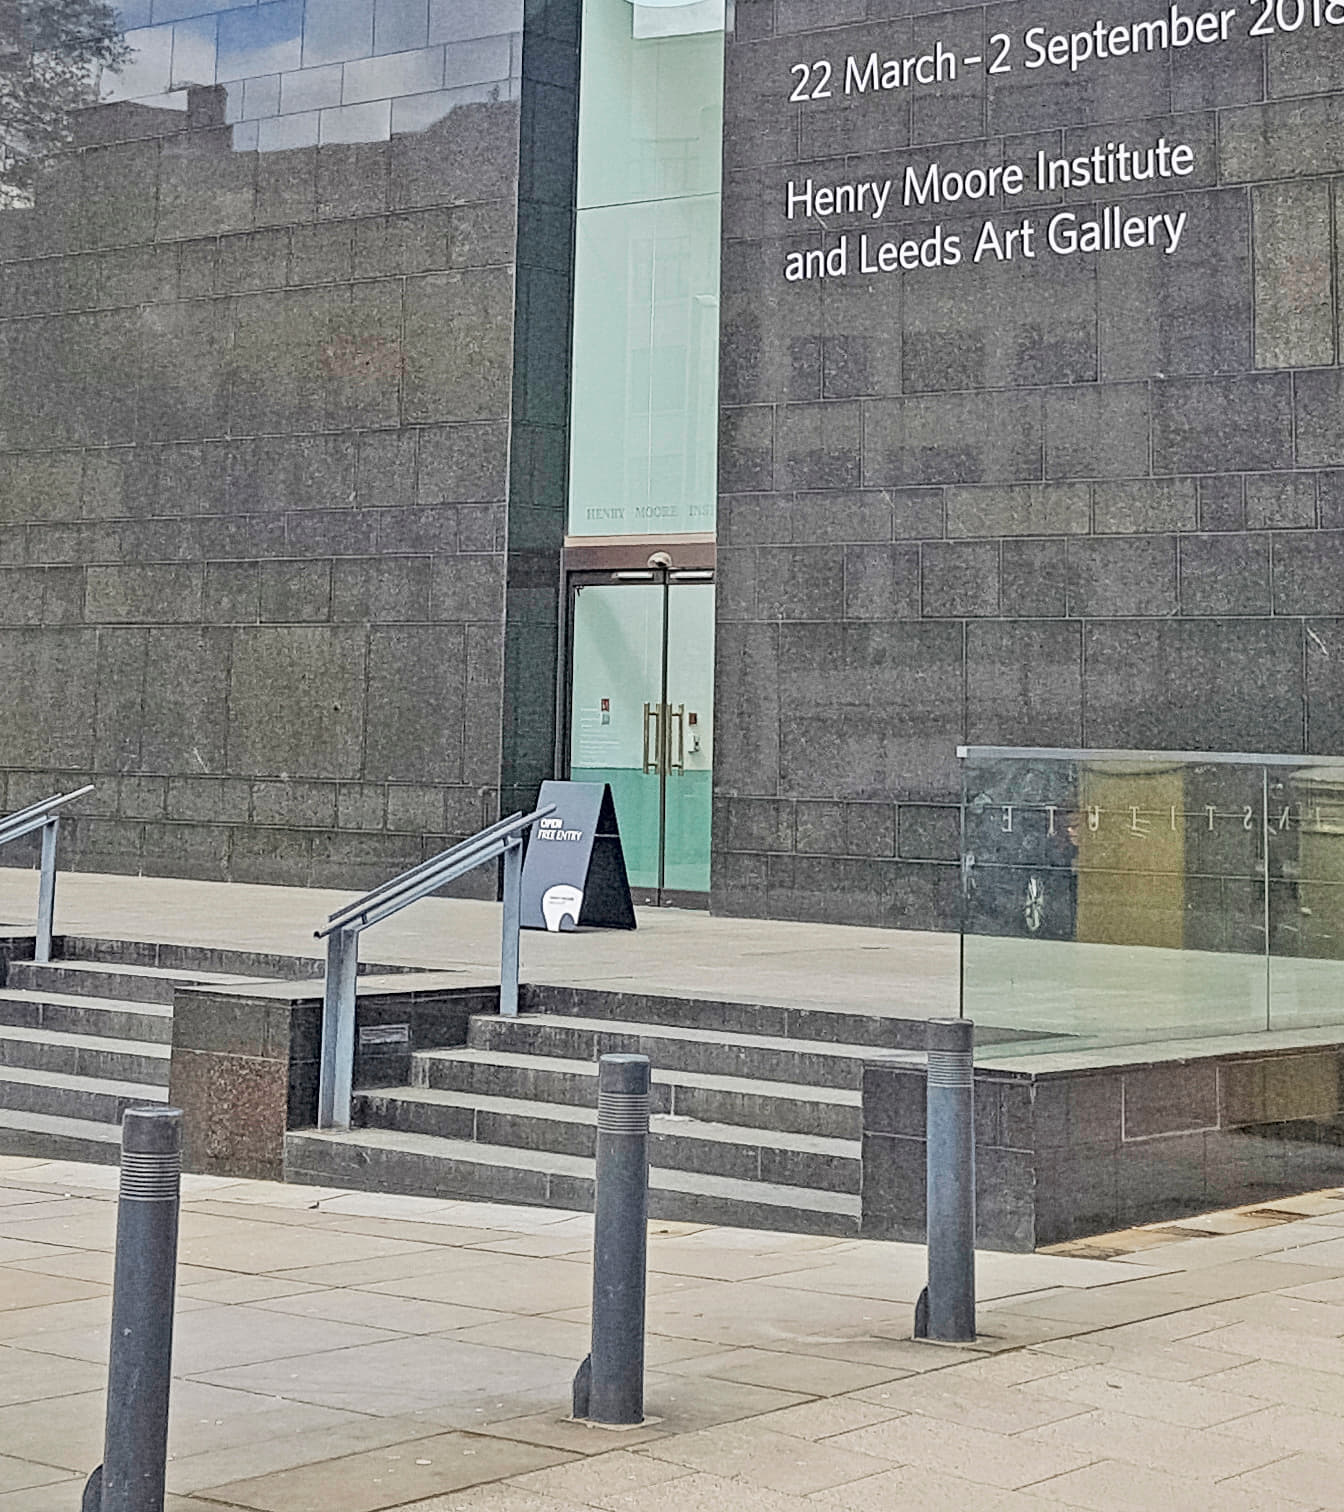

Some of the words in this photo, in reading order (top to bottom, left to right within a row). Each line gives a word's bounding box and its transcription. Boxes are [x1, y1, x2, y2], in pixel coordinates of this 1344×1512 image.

[790, 61, 832, 102] 22
[845, 41, 956, 94] March
[989, 33, 1011, 74] 2
[1025, 4, 1236, 71] September
[787, 175, 891, 219] Henry
[903, 158, 1023, 206] Moore
[1037, 138, 1194, 192] Institute
[785, 236, 847, 281] and
[860, 226, 960, 274] Leeds
[973, 218, 1035, 262] Art
[1047, 206, 1187, 256] Gallery
[537, 829, 556, 840] FREE
[556, 829, 582, 841] ENTRY
[540, 818, 563, 829] OPEN
